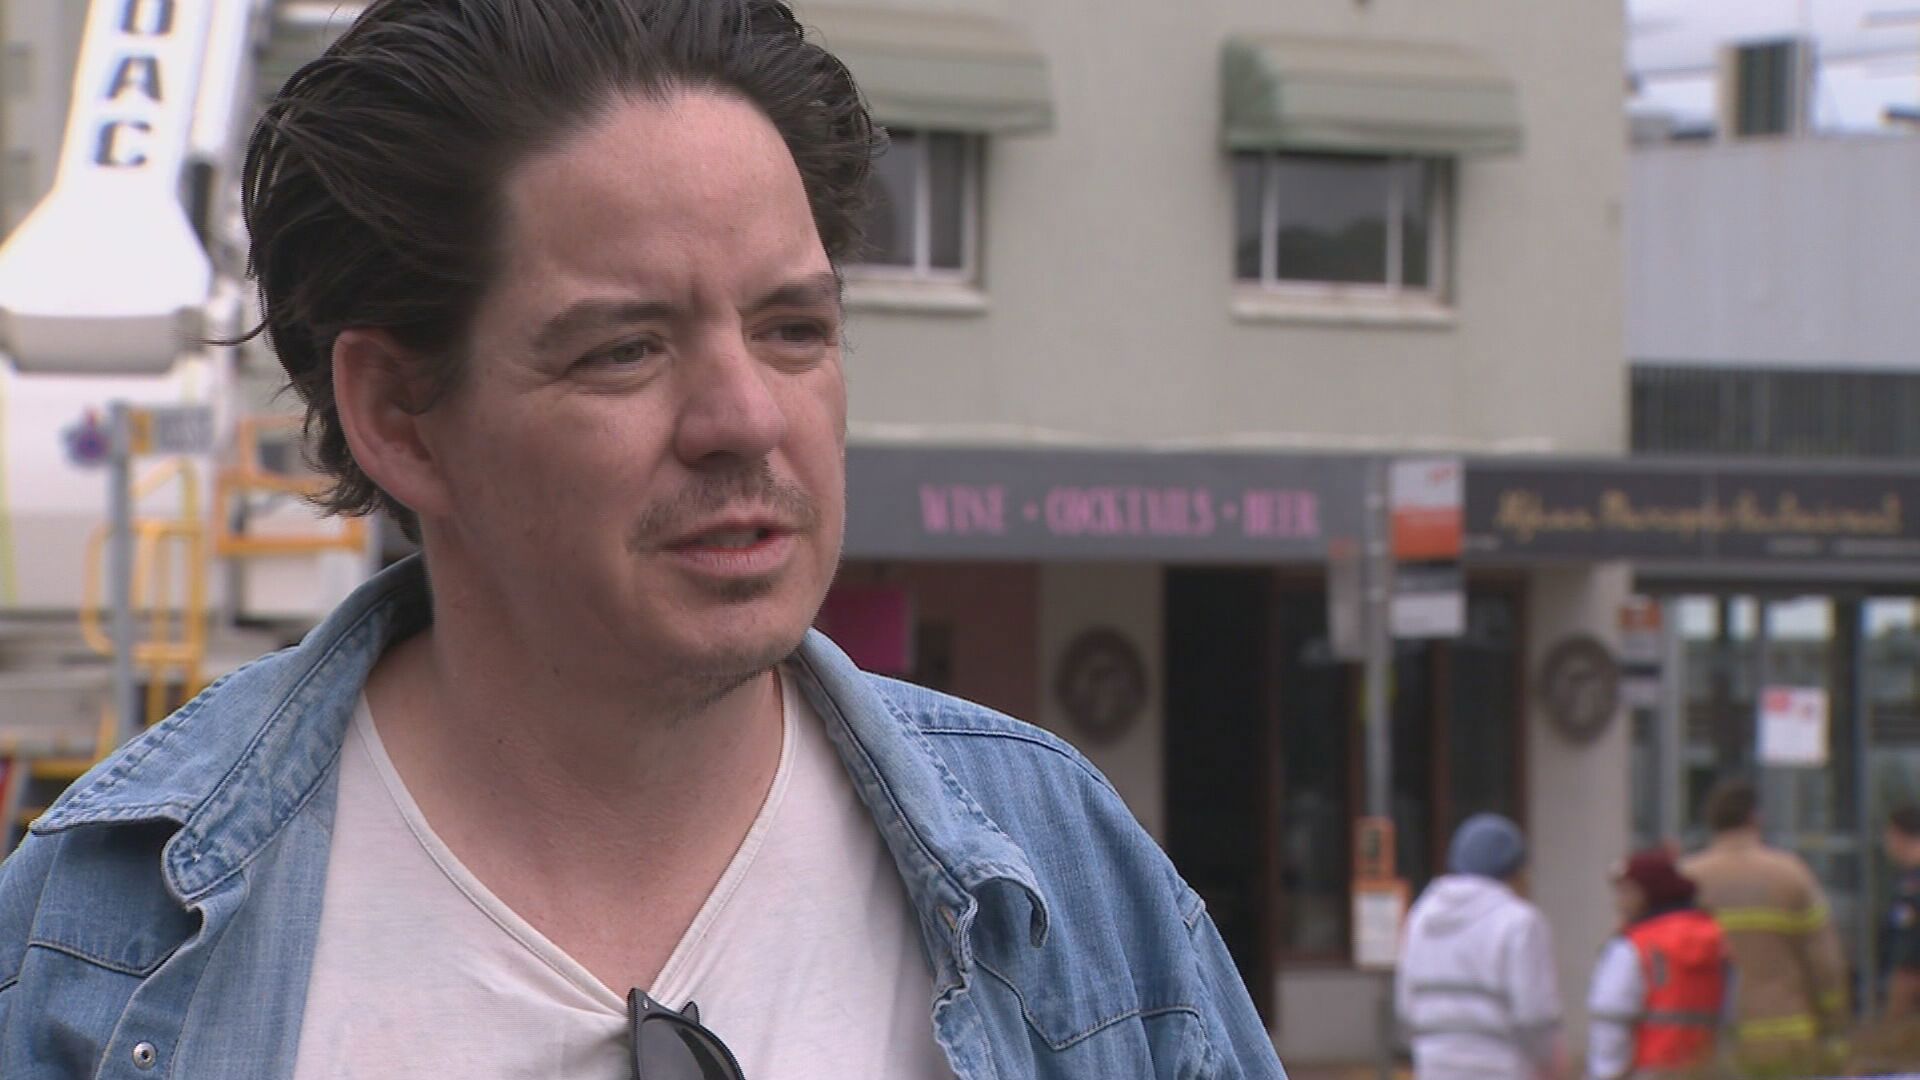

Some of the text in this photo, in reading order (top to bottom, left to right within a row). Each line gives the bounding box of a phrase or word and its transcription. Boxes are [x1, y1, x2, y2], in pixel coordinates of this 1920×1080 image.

[921, 486, 1320, 537] WINE COCKTAILS BEER
